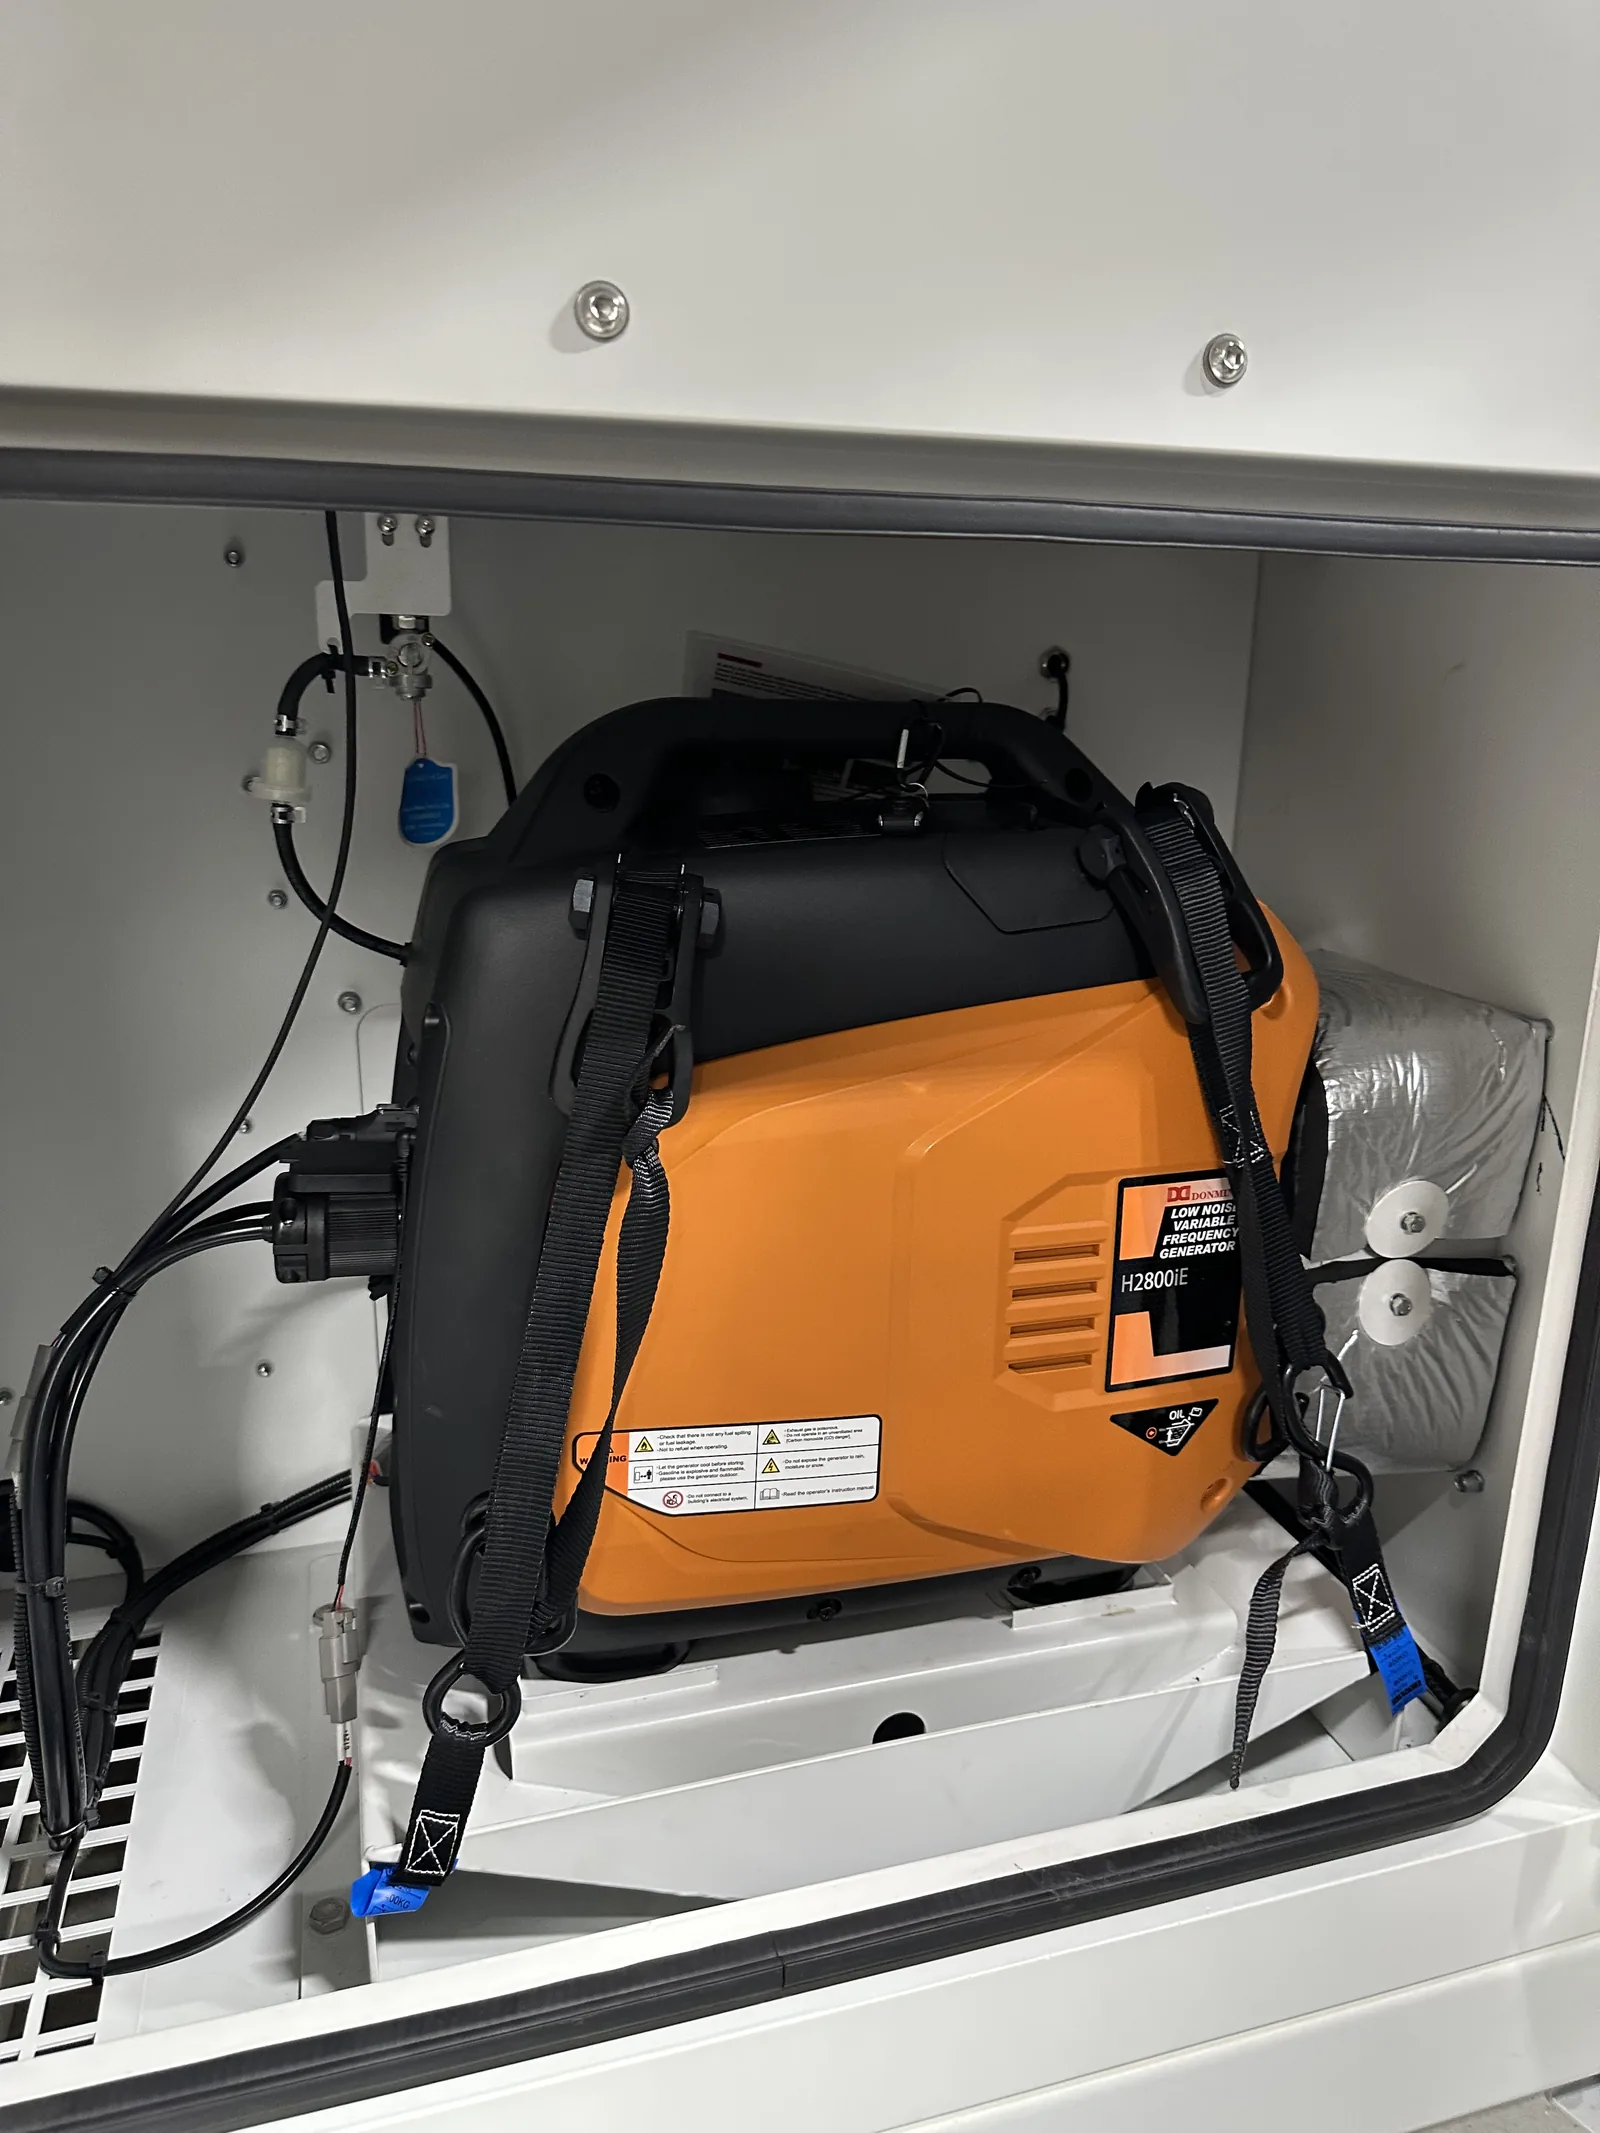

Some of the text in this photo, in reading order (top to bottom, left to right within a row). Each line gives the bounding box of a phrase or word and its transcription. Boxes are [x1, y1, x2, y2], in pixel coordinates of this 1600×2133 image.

[1171, 1205, 1200, 1219] LOW
[1173, 1215, 1236, 1231] VARIABLE
[1162, 1227, 1240, 1246] FREQUENCY
[1159, 1241, 1236, 1259] GENERATOR
[1121, 1267, 1189, 1293] H2800iE
[1168, 1409, 1186, 1420] OIL
[579, 1455, 627, 1465] WING
[385, 1893, 411, 1910] 00KG
